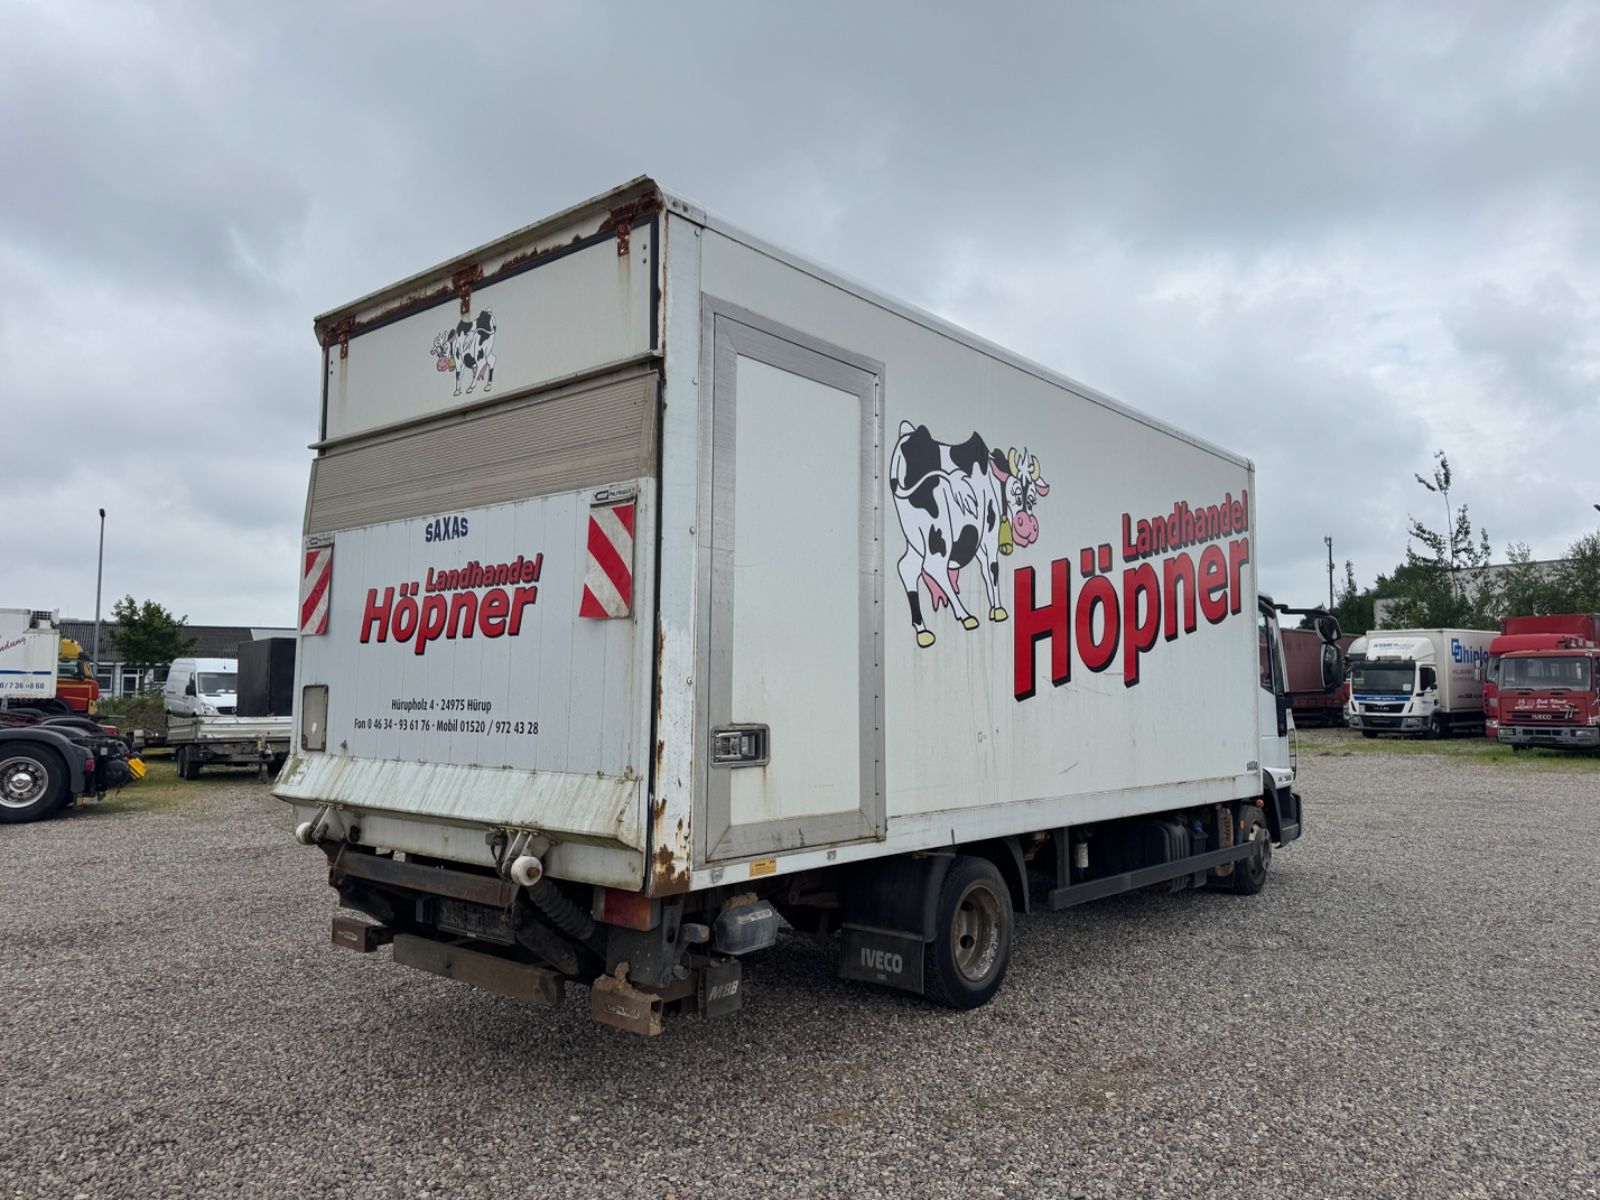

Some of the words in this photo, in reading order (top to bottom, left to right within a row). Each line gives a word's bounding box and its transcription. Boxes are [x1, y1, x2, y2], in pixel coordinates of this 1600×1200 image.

[425, 516, 468, 543] SAXAS
[1122, 490, 1248, 562] Landhandel
[426, 553, 544, 592] Landhandel
[360, 581, 538, 655] Höpner
[1014, 537, 1249, 702] Höpner
[392, 698, 427, 713] Hürupholz
[429, 699, 435, 711] 4
[440, 699, 465, 711] 24975
[467, 699, 492, 715] Hürup
[354, 718, 366, 729] Fon
[367, 718, 372, 729] 0
[374, 718, 382, 730] 46
[384, 718, 392, 730] 34
[399, 719, 408, 730] 93
[410, 719, 418, 731] 61
[421, 719, 430, 731] 76
[436, 718, 458, 732] Mobil
[460, 719, 485, 733] 01520
[495, 721, 511, 734] 972
[514, 721, 525, 734] 43
[528, 721, 539, 735] 28
[861, 947, 903, 973] IVECO
[709, 979, 739, 1001] MBB
